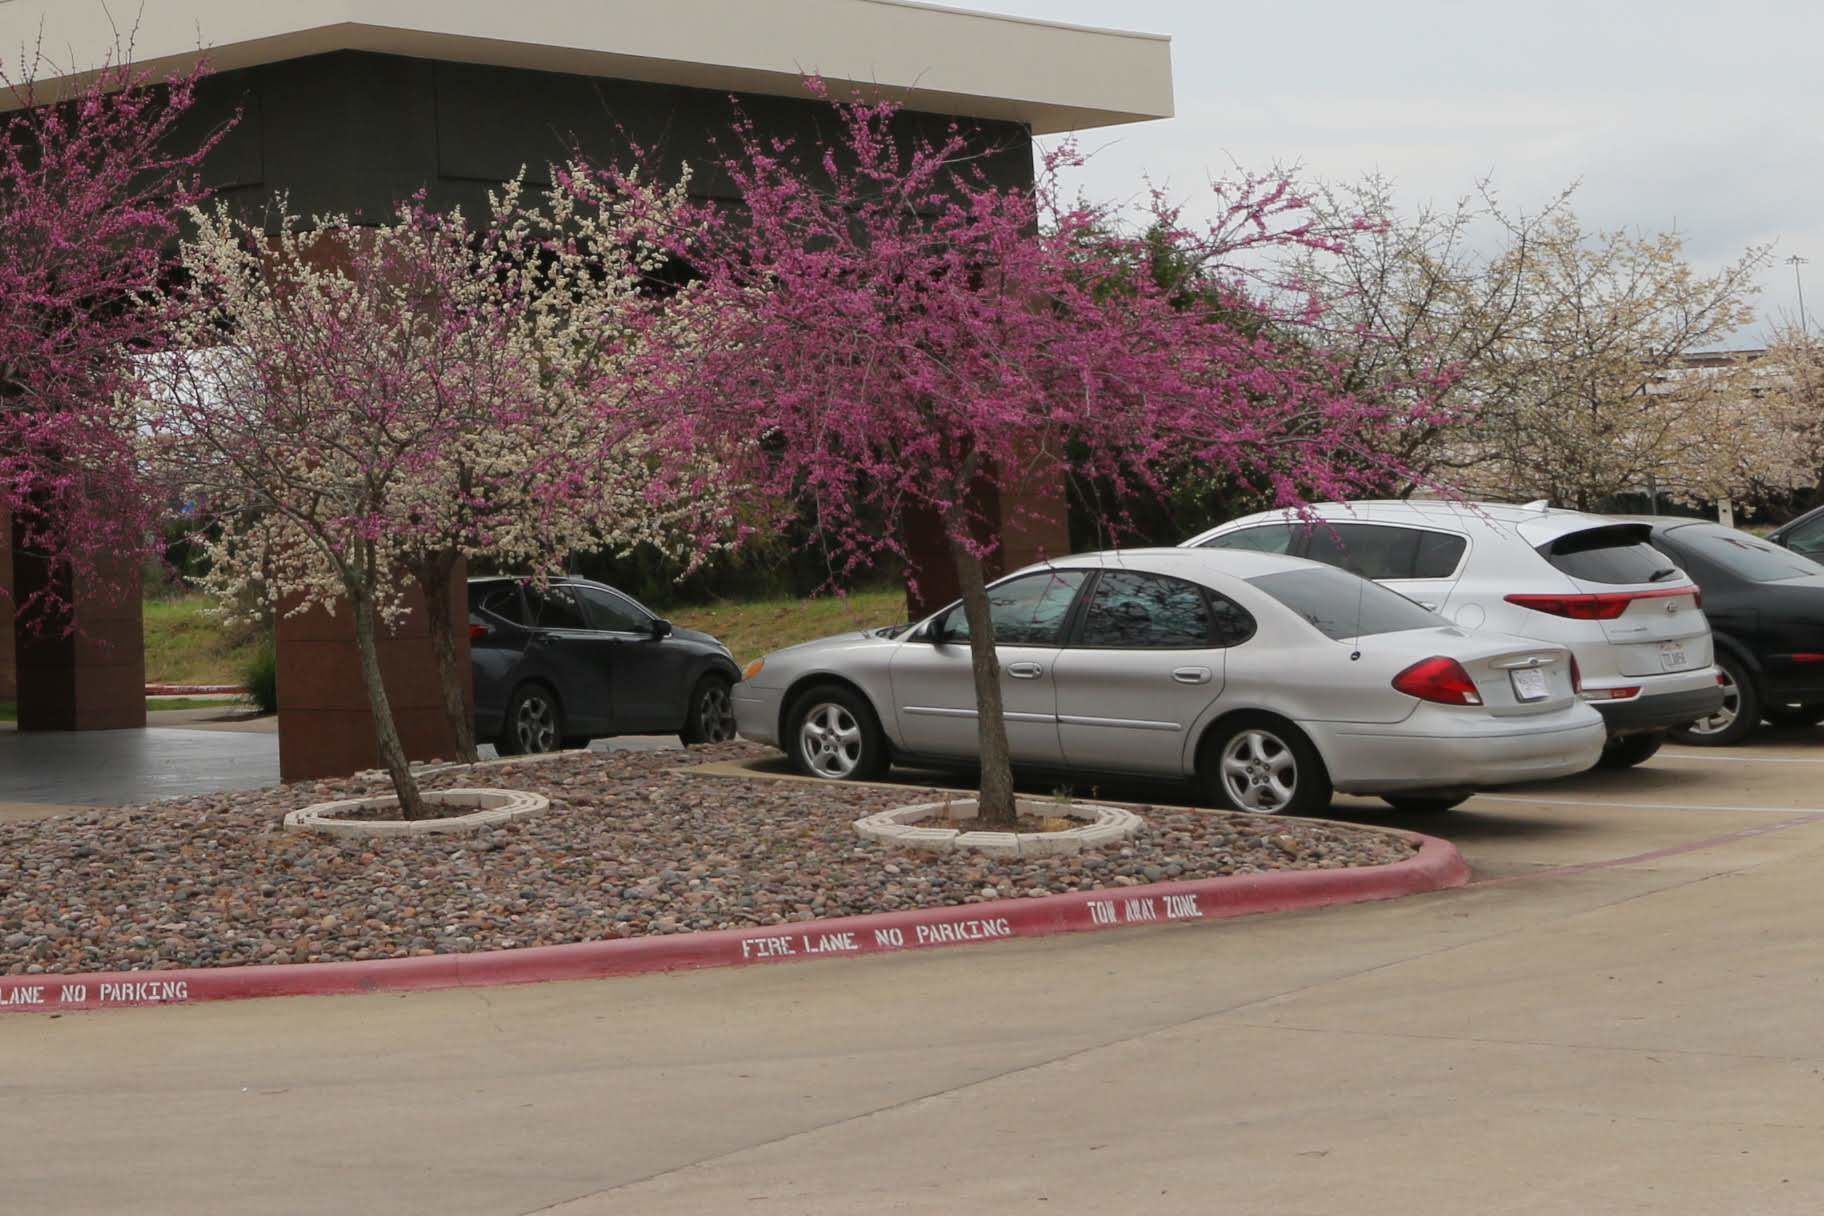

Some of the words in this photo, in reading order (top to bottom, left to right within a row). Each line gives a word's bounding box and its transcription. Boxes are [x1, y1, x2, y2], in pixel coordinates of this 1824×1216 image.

[1087, 900, 1118, 924] TOW
[1124, 897, 1157, 922] AWAY
[1162, 893, 1203, 918] ZONE
[741, 937, 796, 958] FIRE
[803, 932, 859, 953] LANE
[874, 928, 904, 947] NO
[916, 918, 1012, 944] PARKING
[60, 984, 87, 1003] NO
[99, 981, 189, 1001] PARKING
